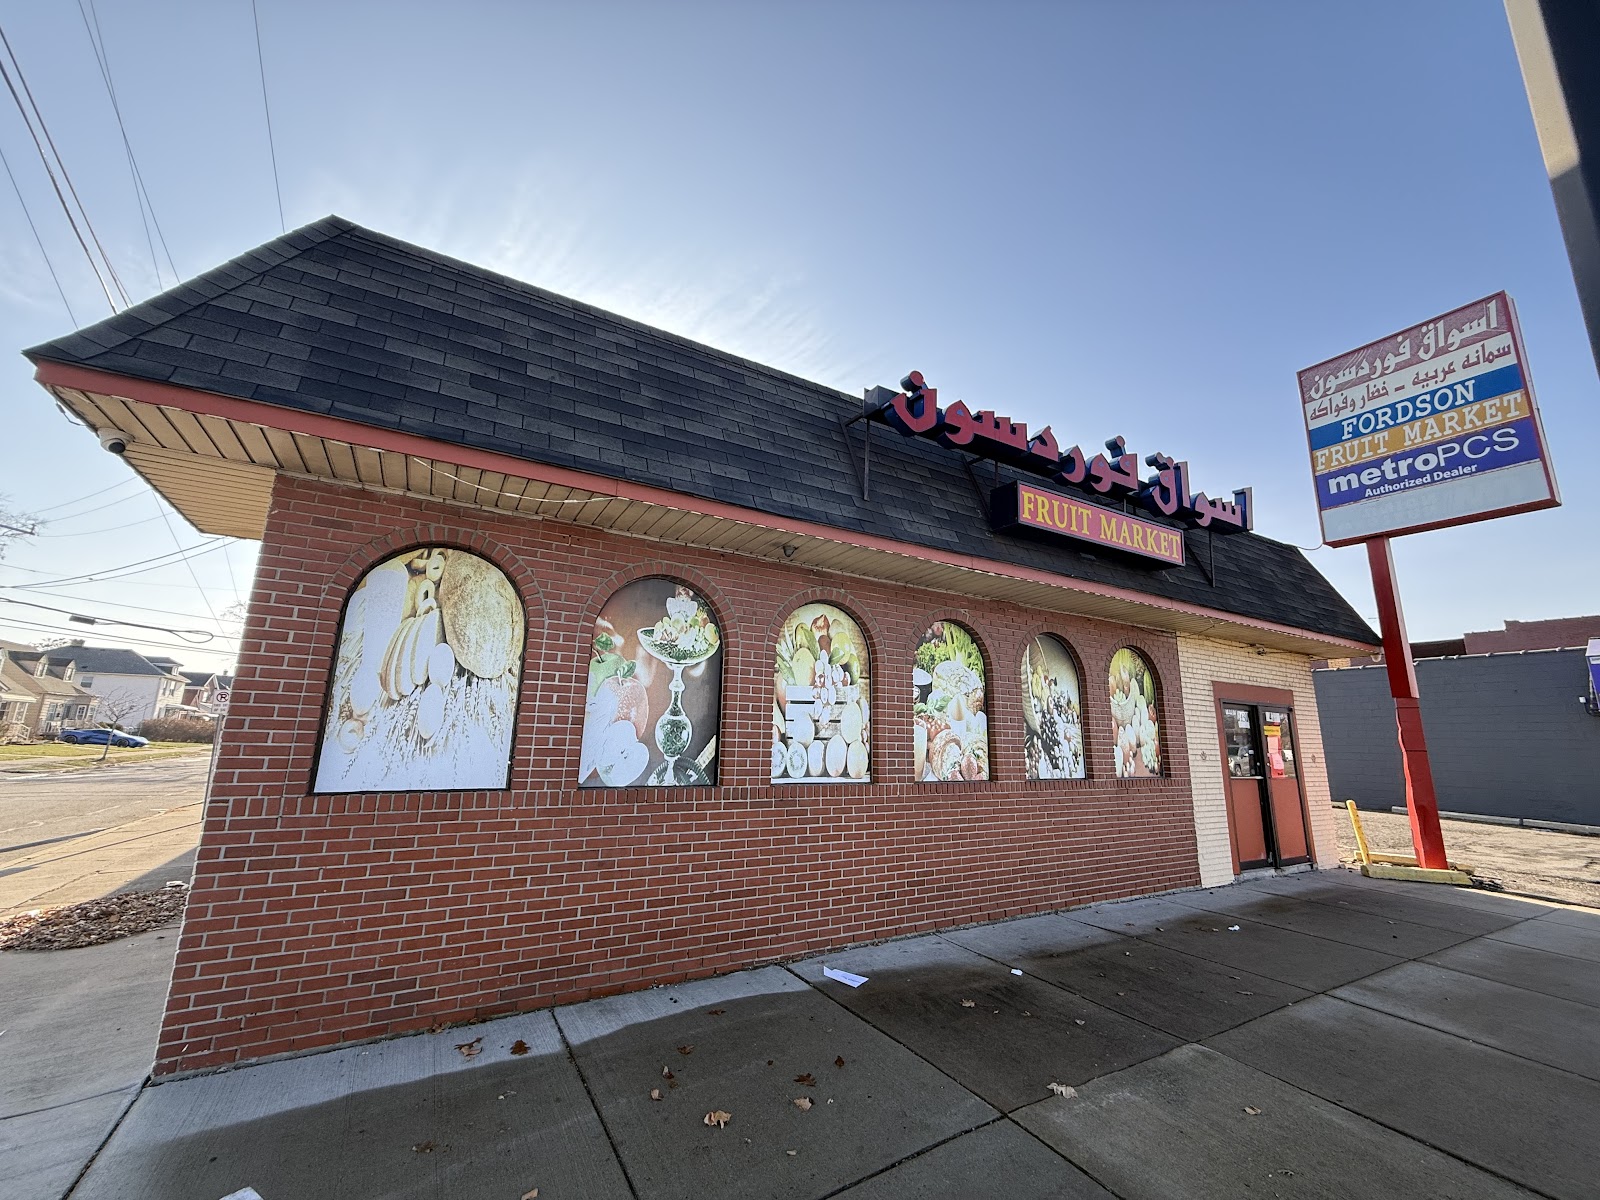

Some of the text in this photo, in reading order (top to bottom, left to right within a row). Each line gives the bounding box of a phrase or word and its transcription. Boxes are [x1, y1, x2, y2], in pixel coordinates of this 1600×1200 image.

[1309, 299, 1498, 400] اسواق فوردسون
[1341, 379, 1476, 440] FORDSON
[1359, 380, 1390, 410] خضار
[888, 370, 1139, 493] فوردسون
[1315, 392, 1522, 471] FRUIT MARKET
[1328, 427, 1520, 494] metroPCS
[1364, 463, 1478, 498] Authorized Dealer
[1021, 490, 1181, 561] FRUIT MARKET
